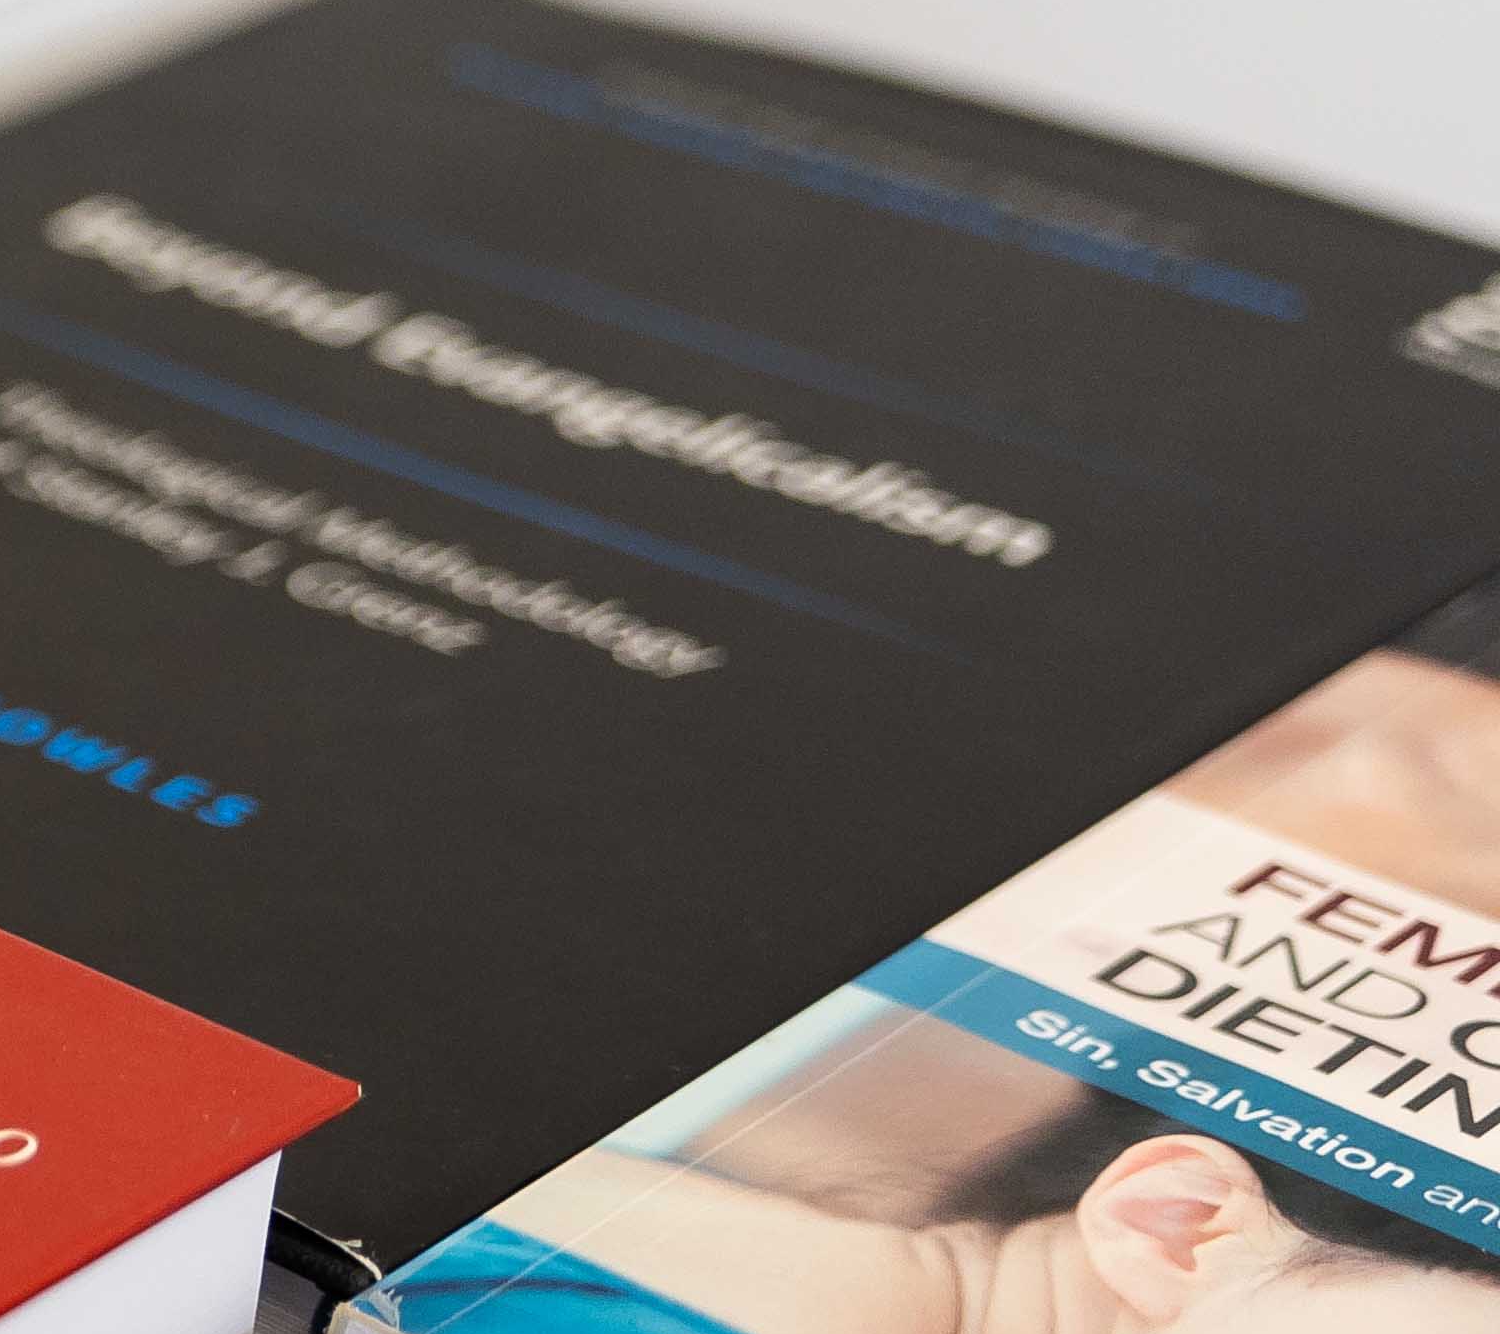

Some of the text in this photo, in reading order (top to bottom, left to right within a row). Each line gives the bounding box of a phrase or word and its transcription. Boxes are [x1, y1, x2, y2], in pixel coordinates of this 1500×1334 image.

[44, 193, 1053, 569] Beyond Evangelicalism
[300, 491, 728, 679] Methodology
[1152, 911, 1427, 1021] AND
[1228, 863, 1500, 999] FEM
[1015, 1009, 1120, 1069] Sin,
[1138, 1057, 1416, 1189] Salvation
